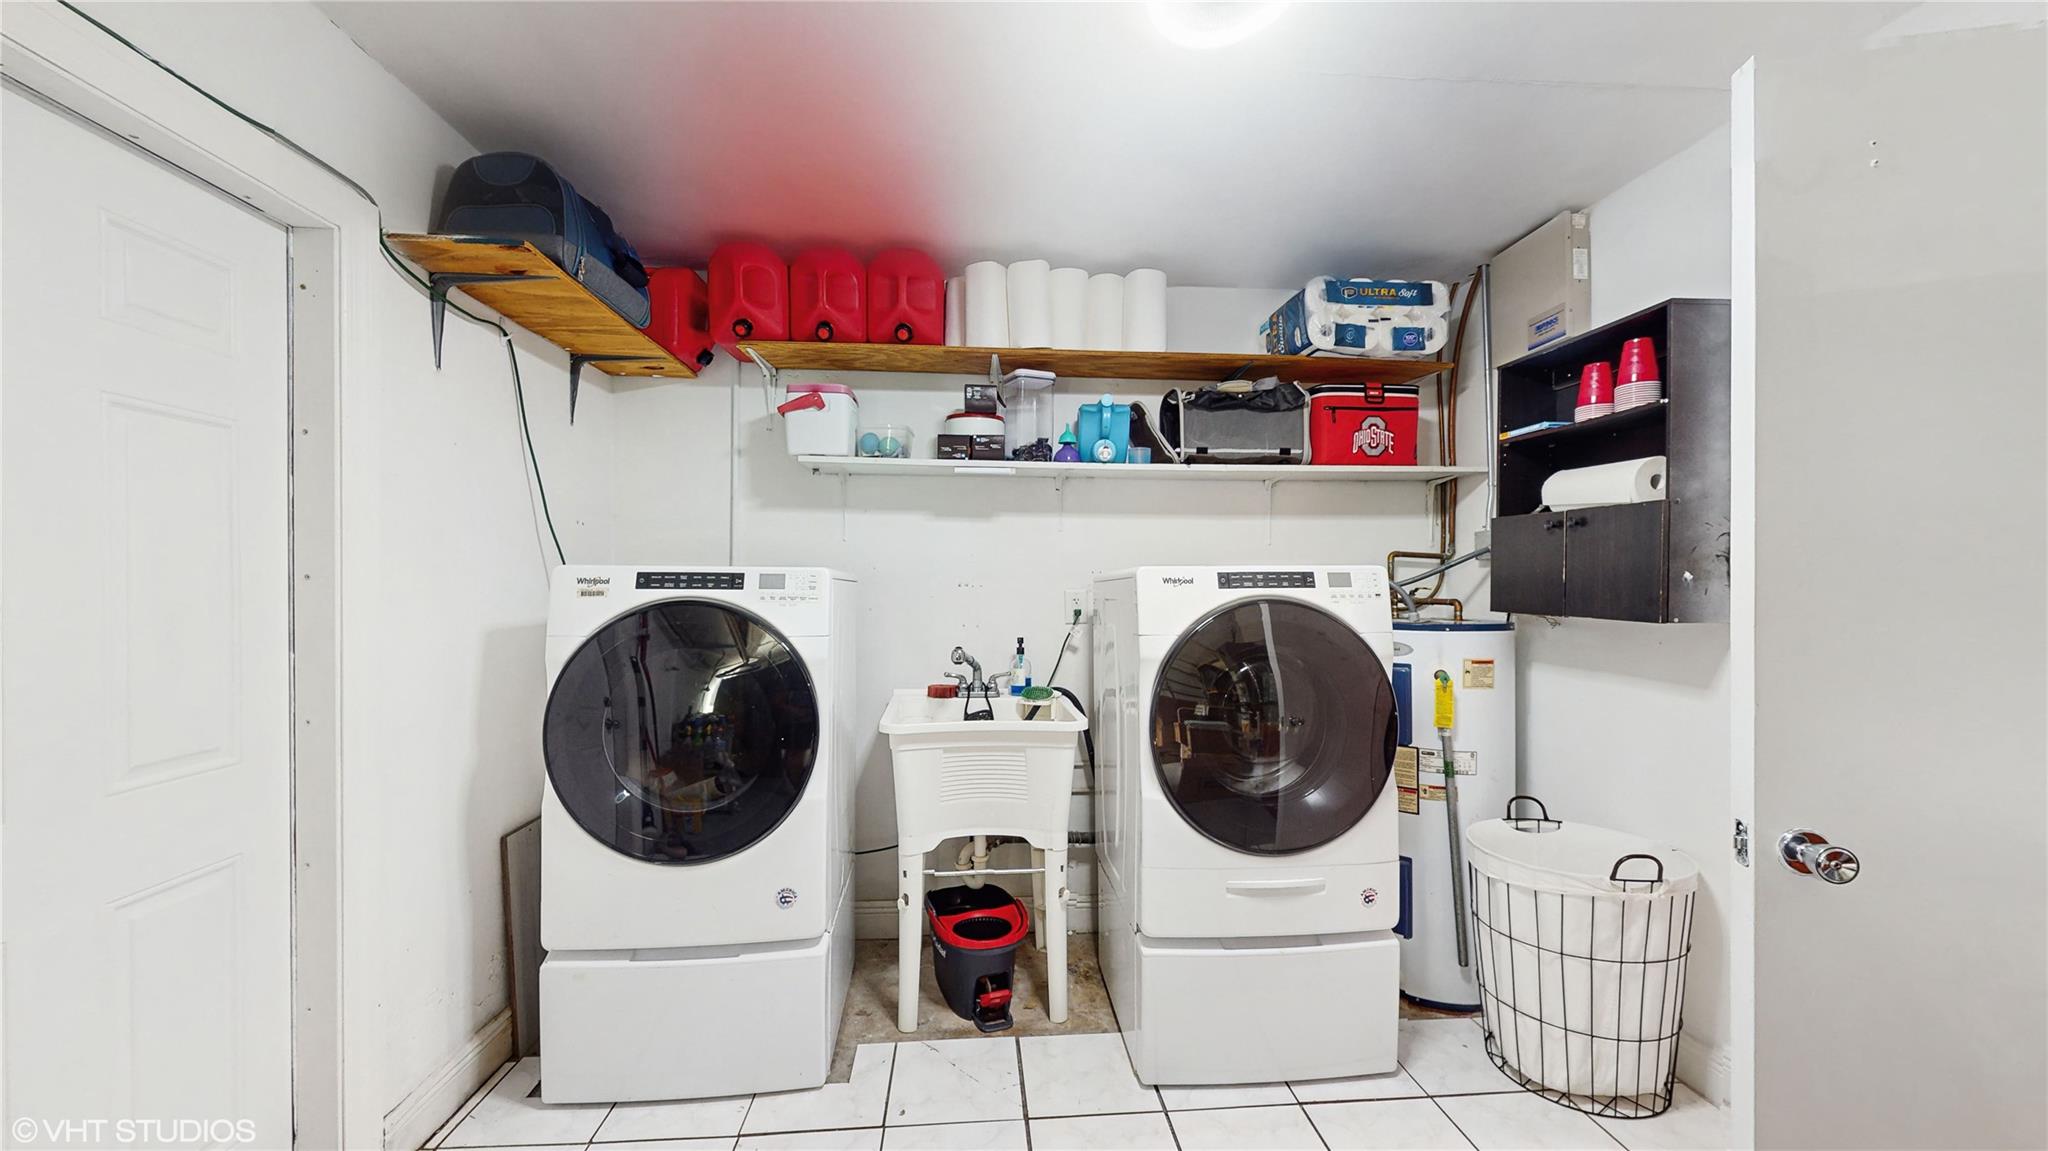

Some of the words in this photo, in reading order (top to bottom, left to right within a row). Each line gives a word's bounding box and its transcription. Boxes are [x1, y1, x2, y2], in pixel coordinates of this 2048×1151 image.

[1360, 288, 1397, 296] ULTRA
[1398, 288, 1418, 298] Soft
[576, 577, 611, 587] Whirlpool
[1162, 577, 1194, 586] Whirlpool
